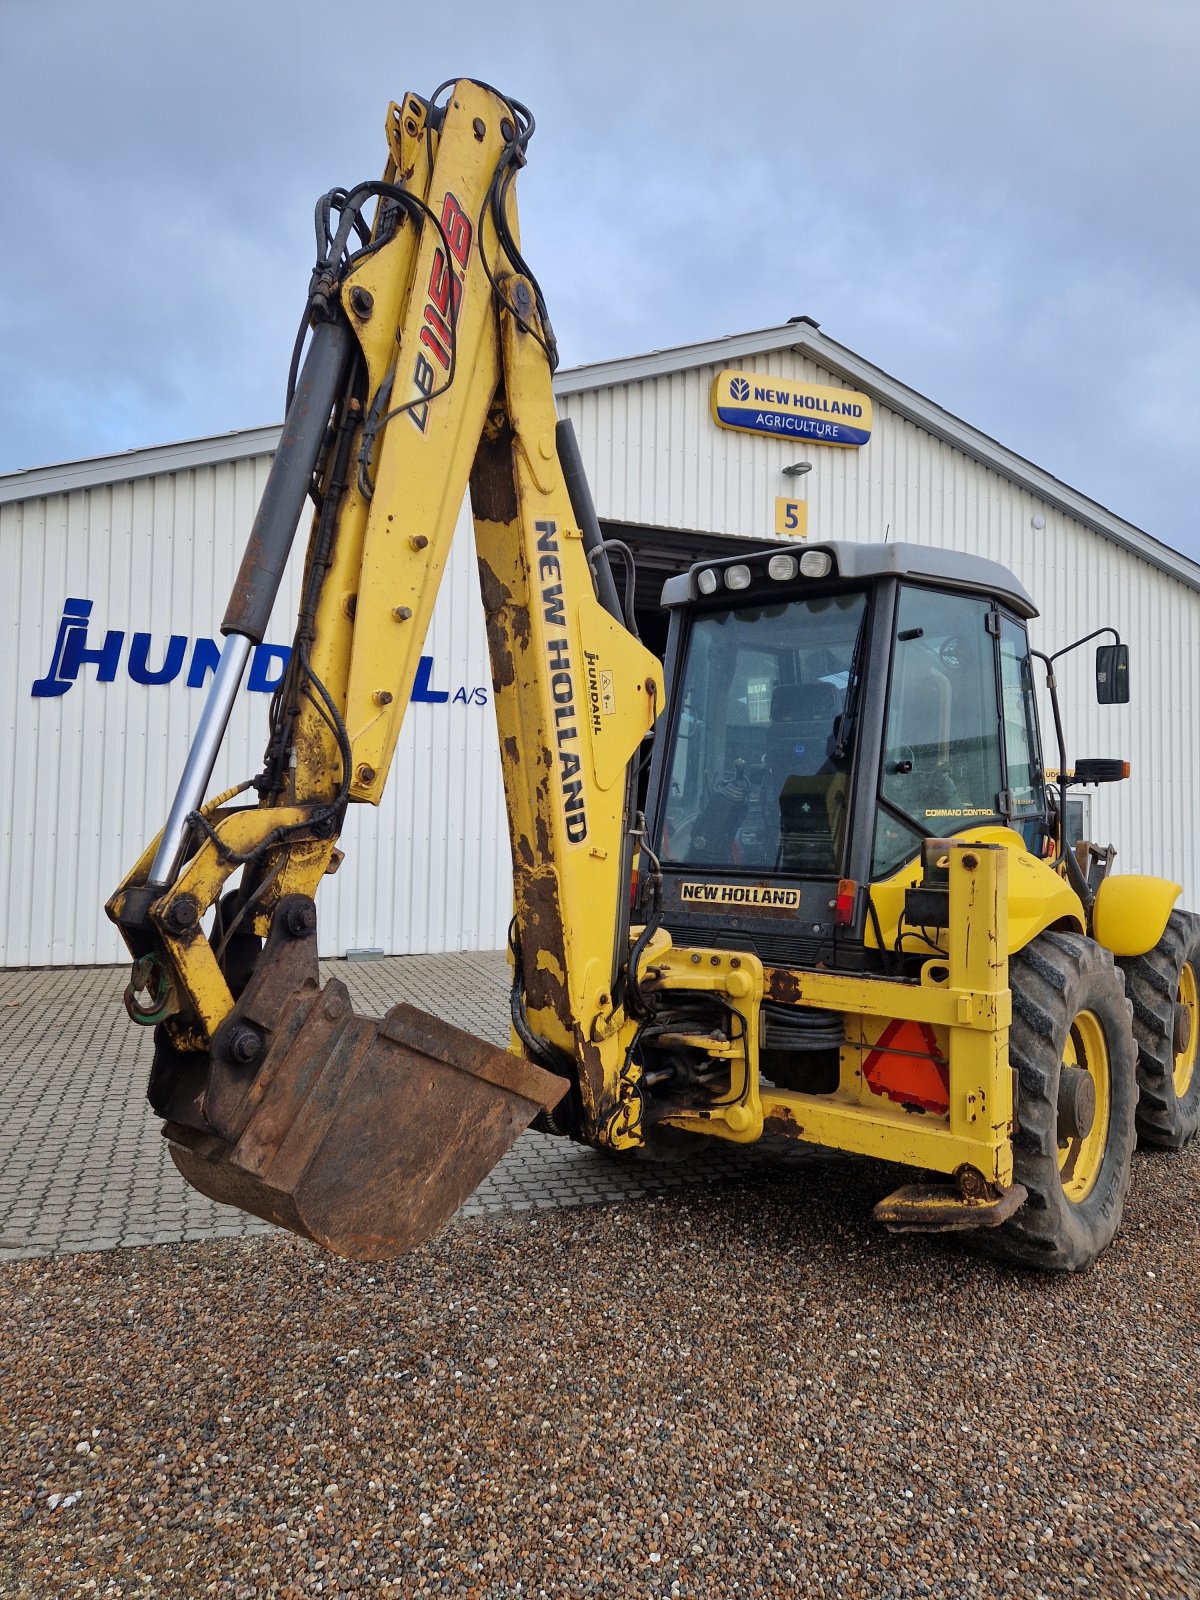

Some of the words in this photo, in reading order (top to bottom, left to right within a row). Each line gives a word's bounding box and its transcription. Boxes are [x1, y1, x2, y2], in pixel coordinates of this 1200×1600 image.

[754, 386, 790, 405] NEW
[793, 394, 863, 417] HOLLAND
[755, 413, 839, 437] AGRICULTURE
[784, 503, 799, 529] 5
[534, 520, 567, 627] NEW
[452, 686, 488, 706] A/S
[547, 638, 588, 844] HOLLAND
[925, 808, 962, 817] COMMAND
[962, 808, 996, 816] CONTROL
[683, 885, 719, 900] NEW
[721, 887, 798, 905] HOLLAND
